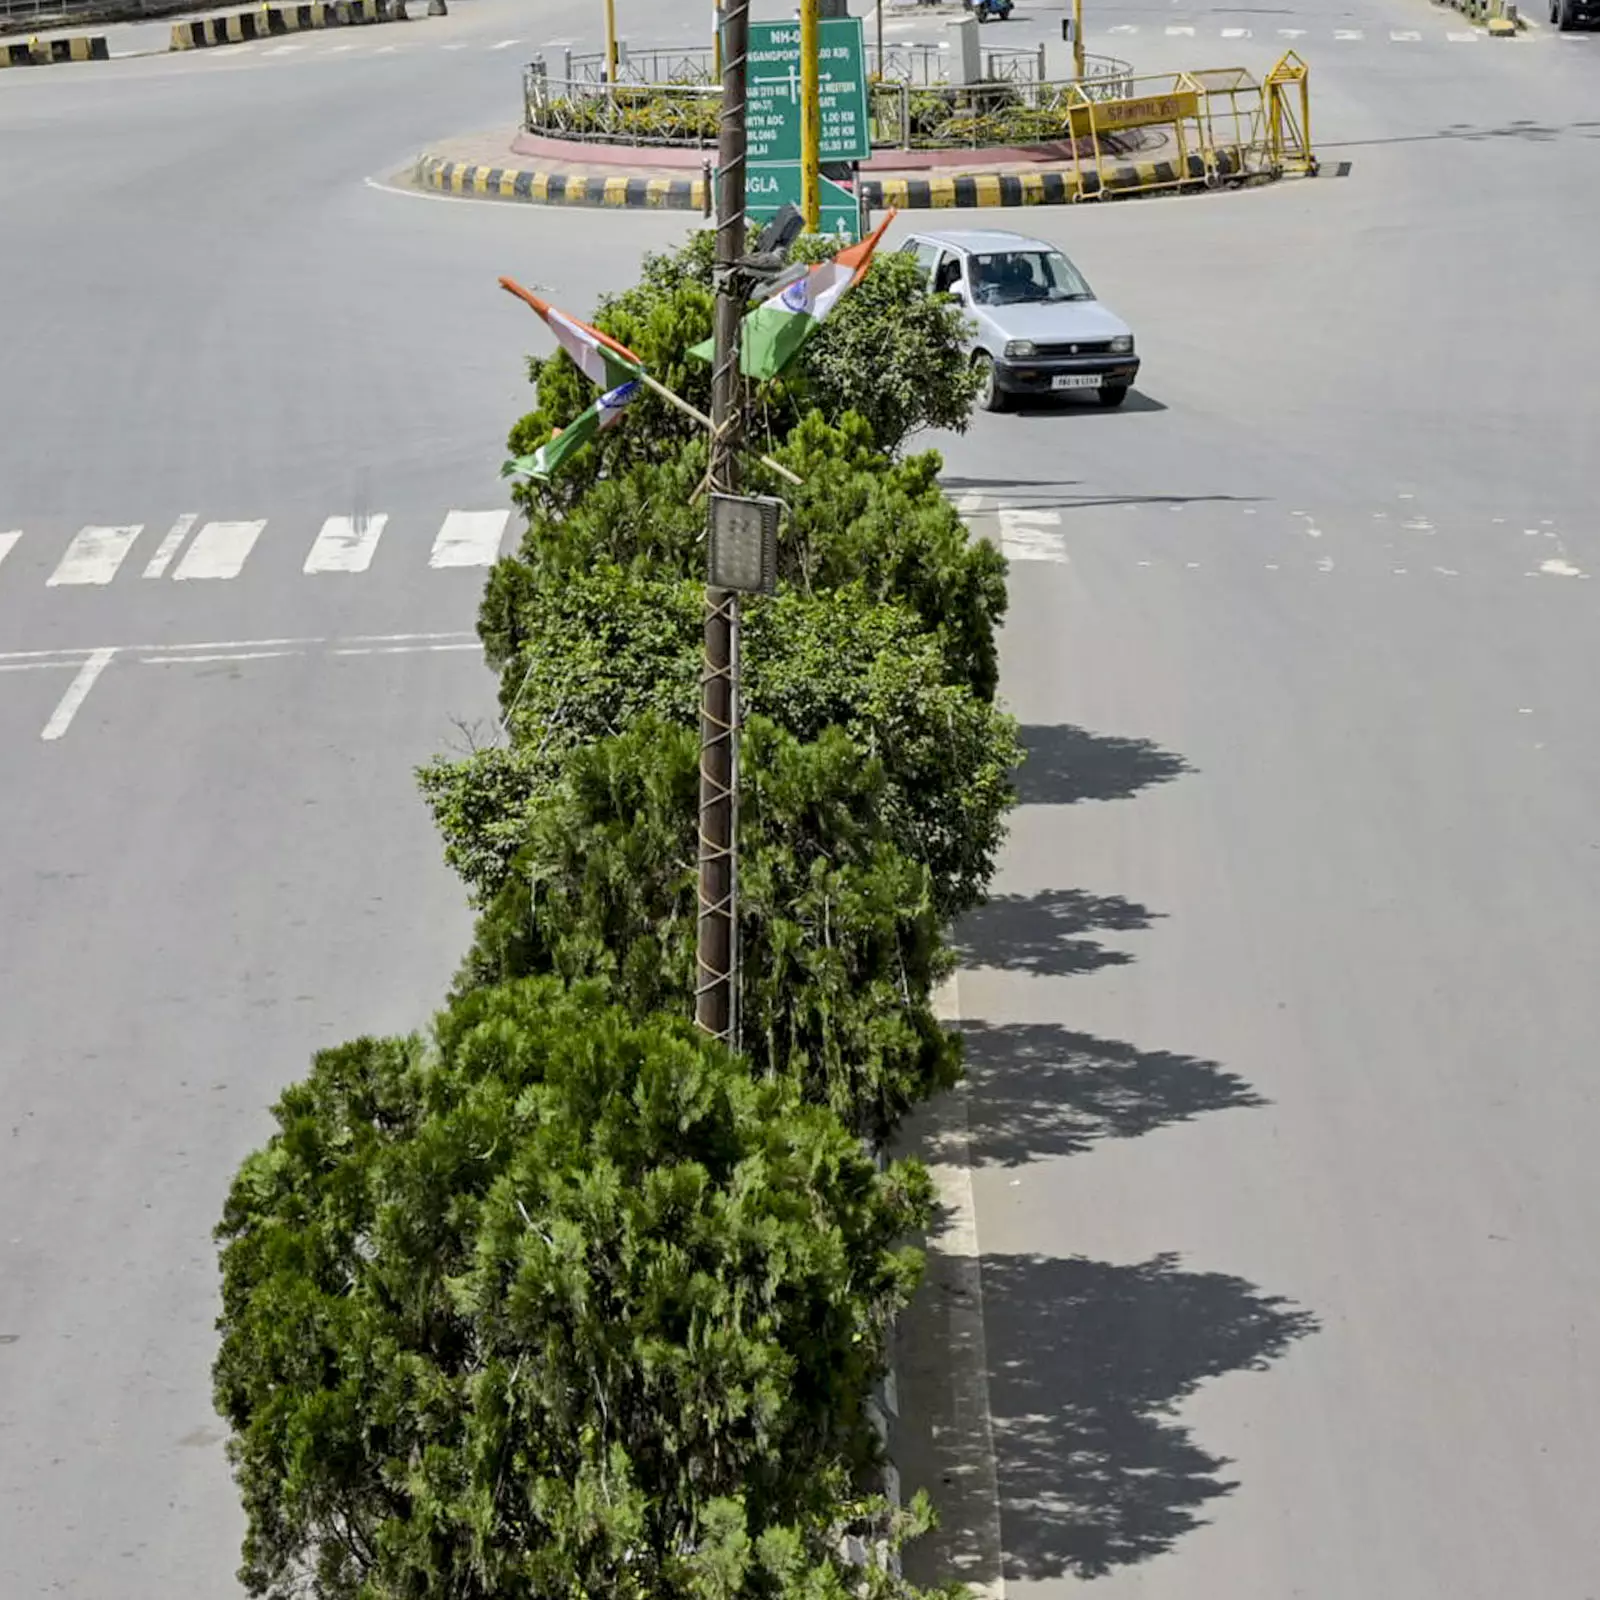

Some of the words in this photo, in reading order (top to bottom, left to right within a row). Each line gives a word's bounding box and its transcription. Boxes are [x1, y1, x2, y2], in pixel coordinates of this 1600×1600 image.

[771, 30, 801, 44] NH-0
[841, 111, 855, 122] KM
[842, 125, 855, 136] KM
